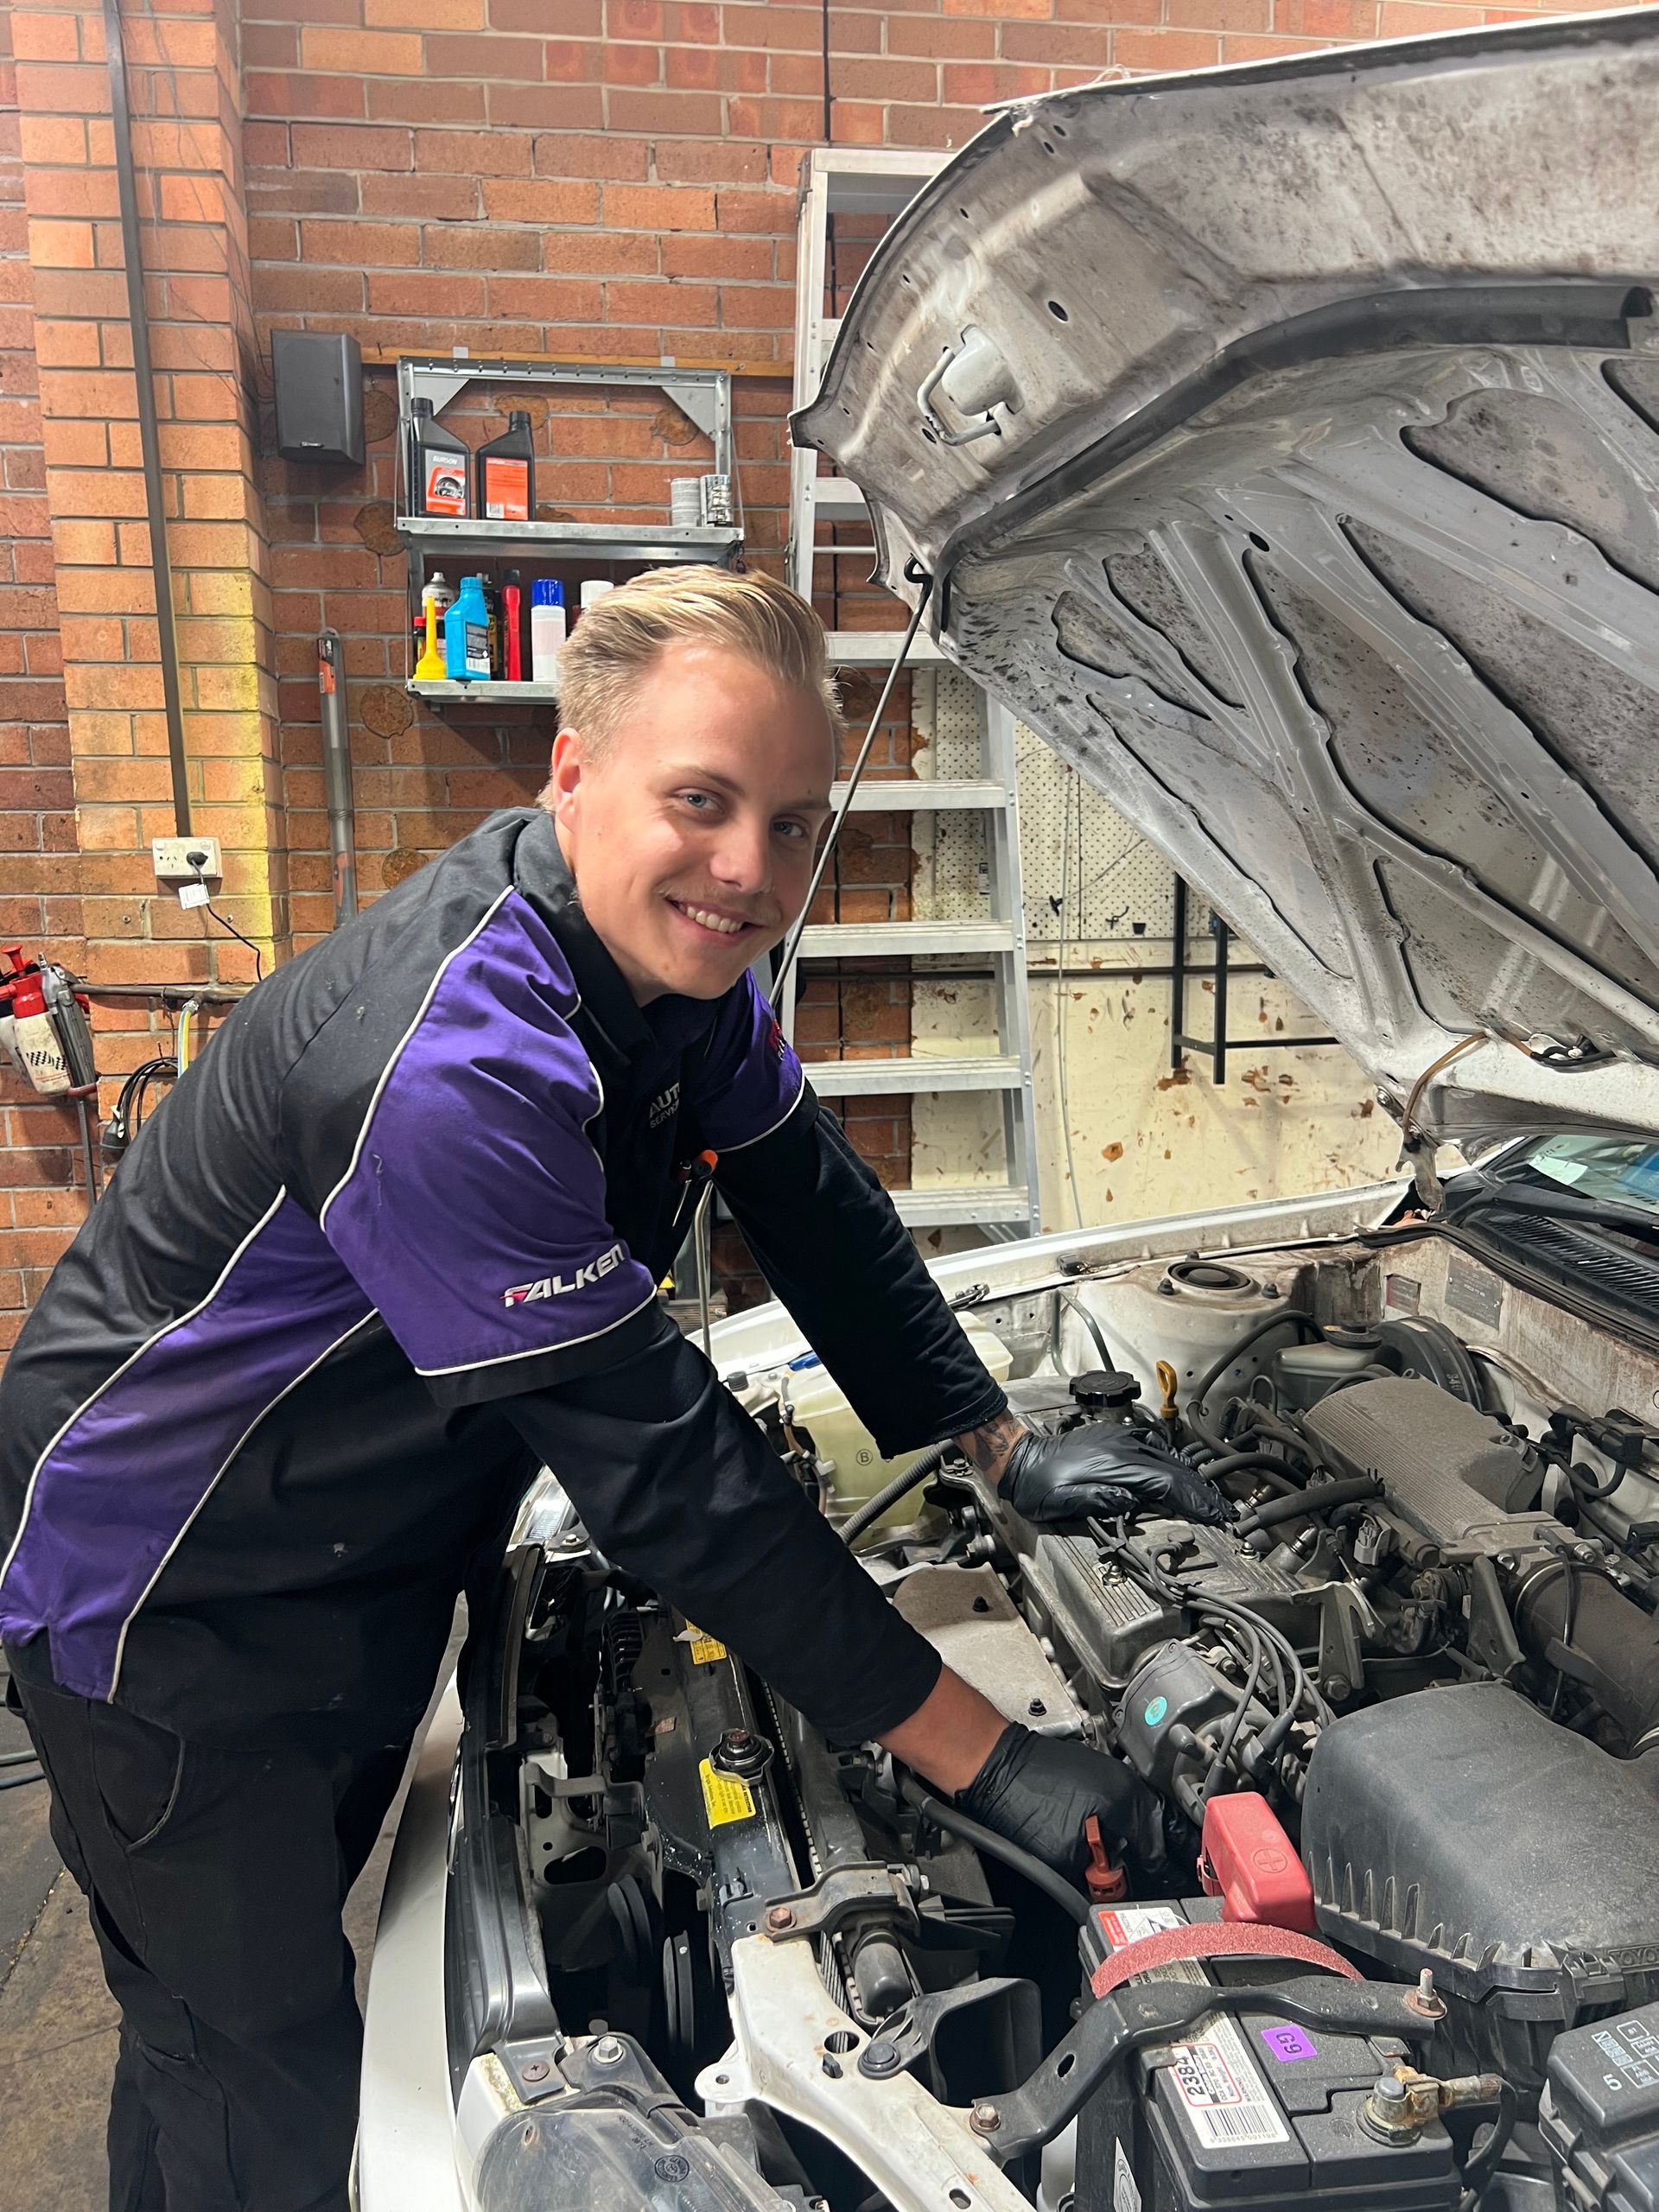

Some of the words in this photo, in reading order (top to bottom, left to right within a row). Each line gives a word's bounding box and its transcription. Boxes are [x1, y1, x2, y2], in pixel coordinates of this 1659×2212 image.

[649, 1082, 680, 1119] AUT
[499, 1243, 626, 1308] FALKEN
[1275, 2032, 1302, 2054] G9
[1177, 2056, 1205, 2096] 2384
[1602, 2073, 1623, 2091] 5
